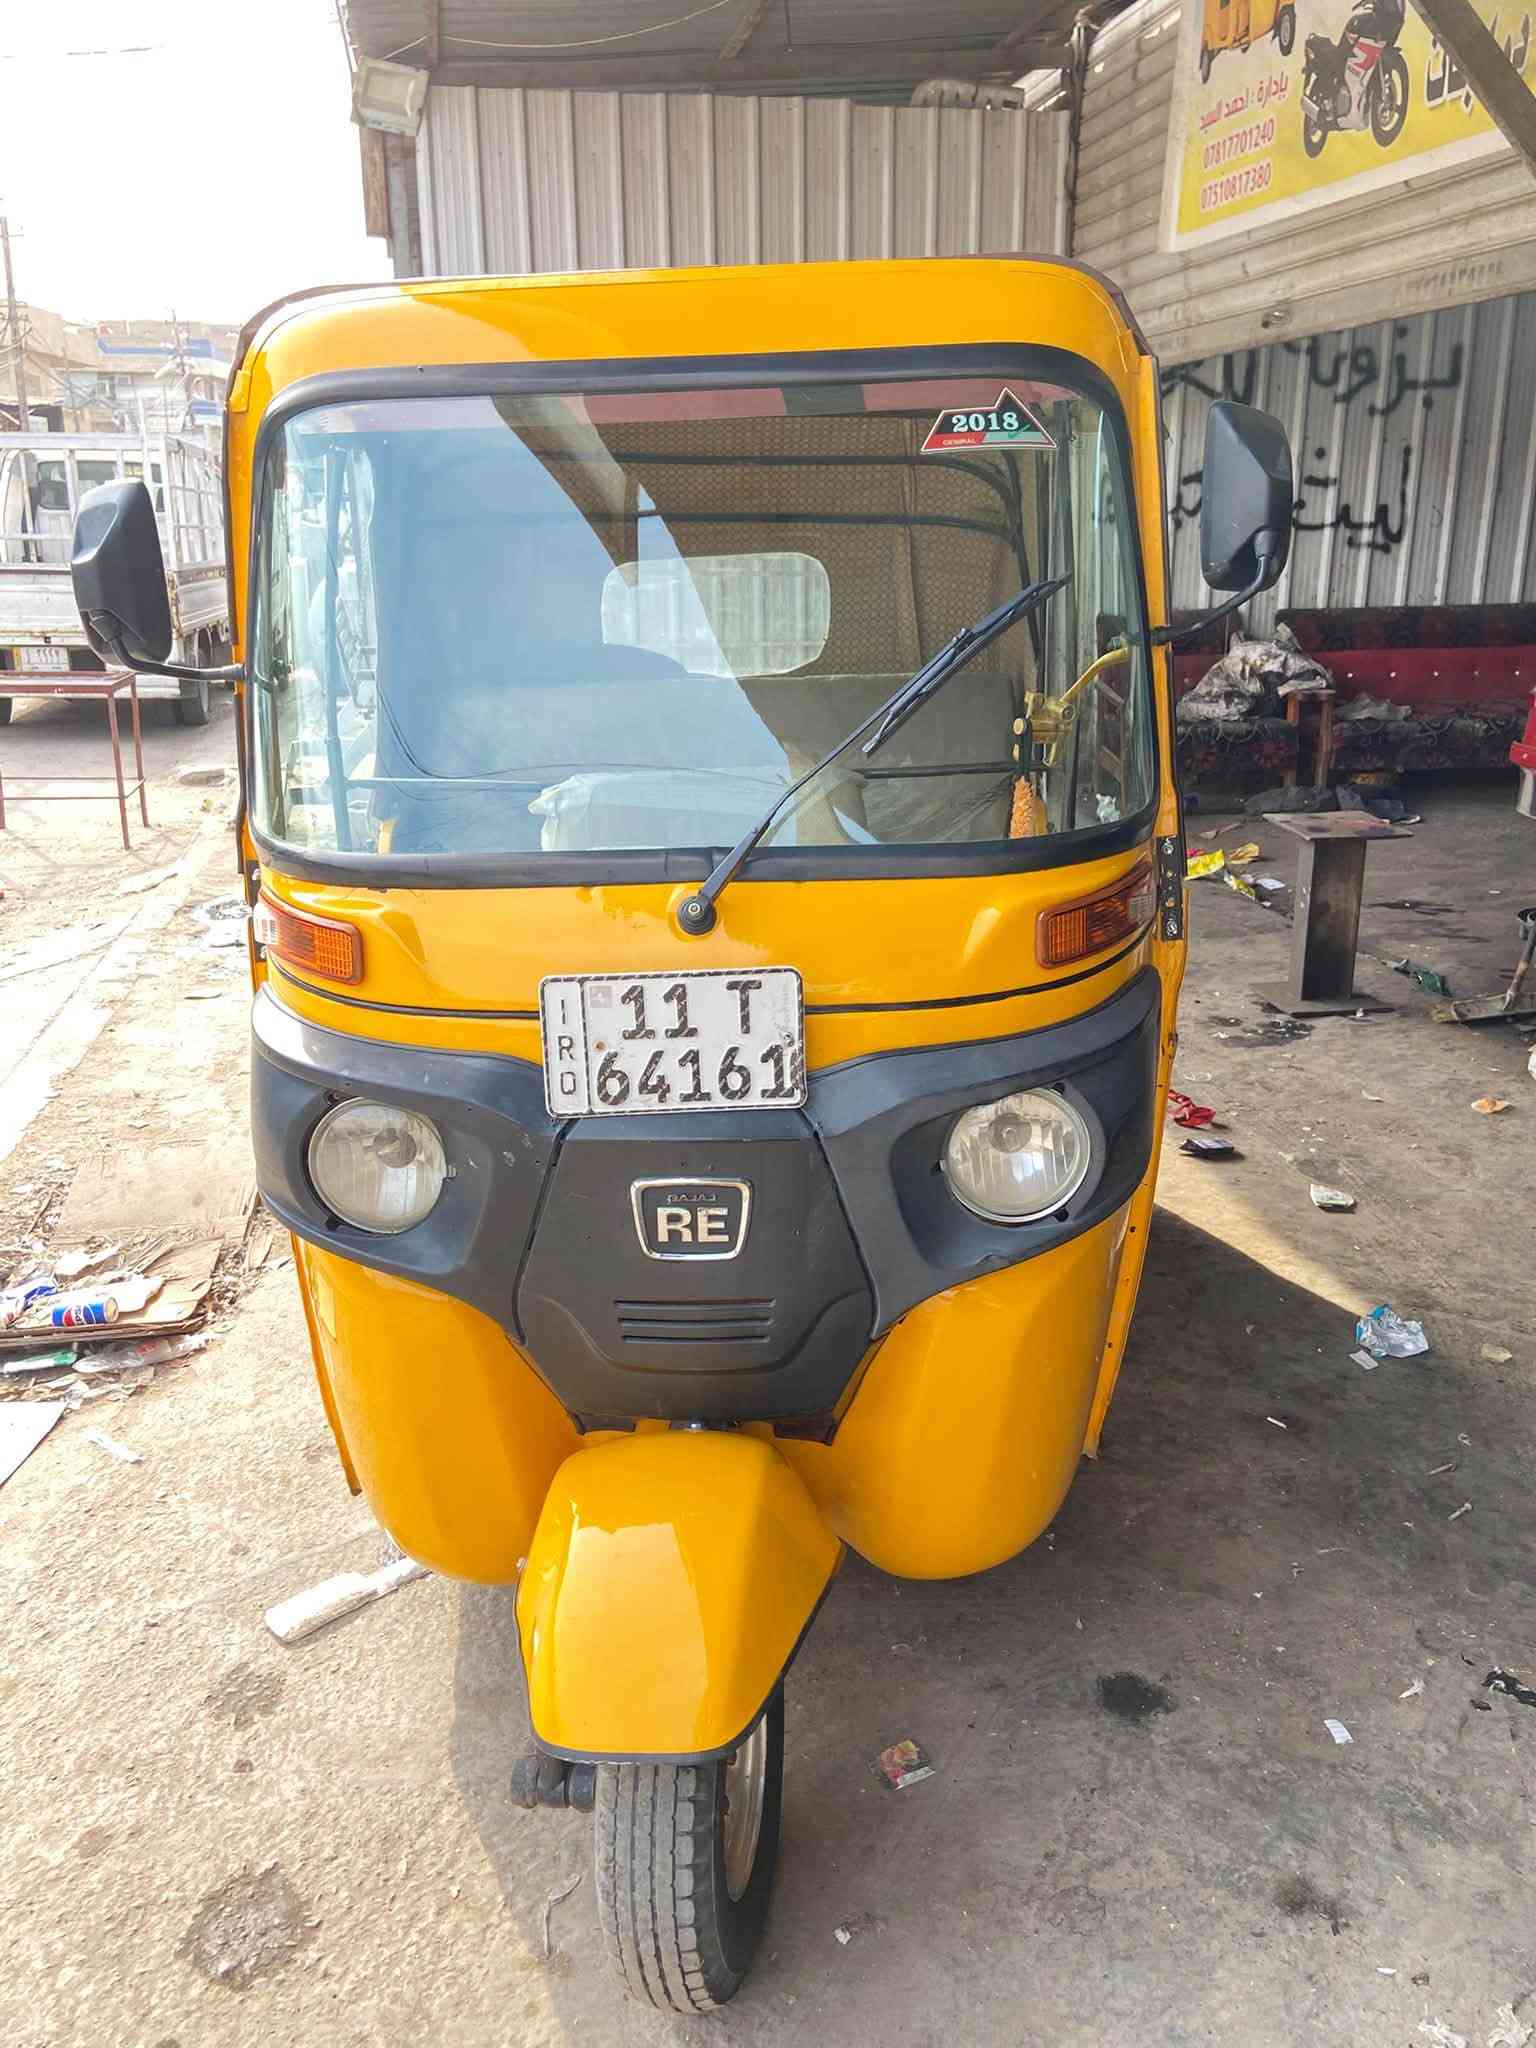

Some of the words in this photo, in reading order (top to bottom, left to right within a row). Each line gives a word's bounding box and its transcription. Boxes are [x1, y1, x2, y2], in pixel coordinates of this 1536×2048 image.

[1201, 162, 1272, 209] 07510817380
[951, 411, 1019, 433] 2018
[620, 983, 699, 1040] 11
[726, 979, 762, 1034] T
[596, 1045, 797, 1106] 64161
[656, 1206, 729, 1242] RE
